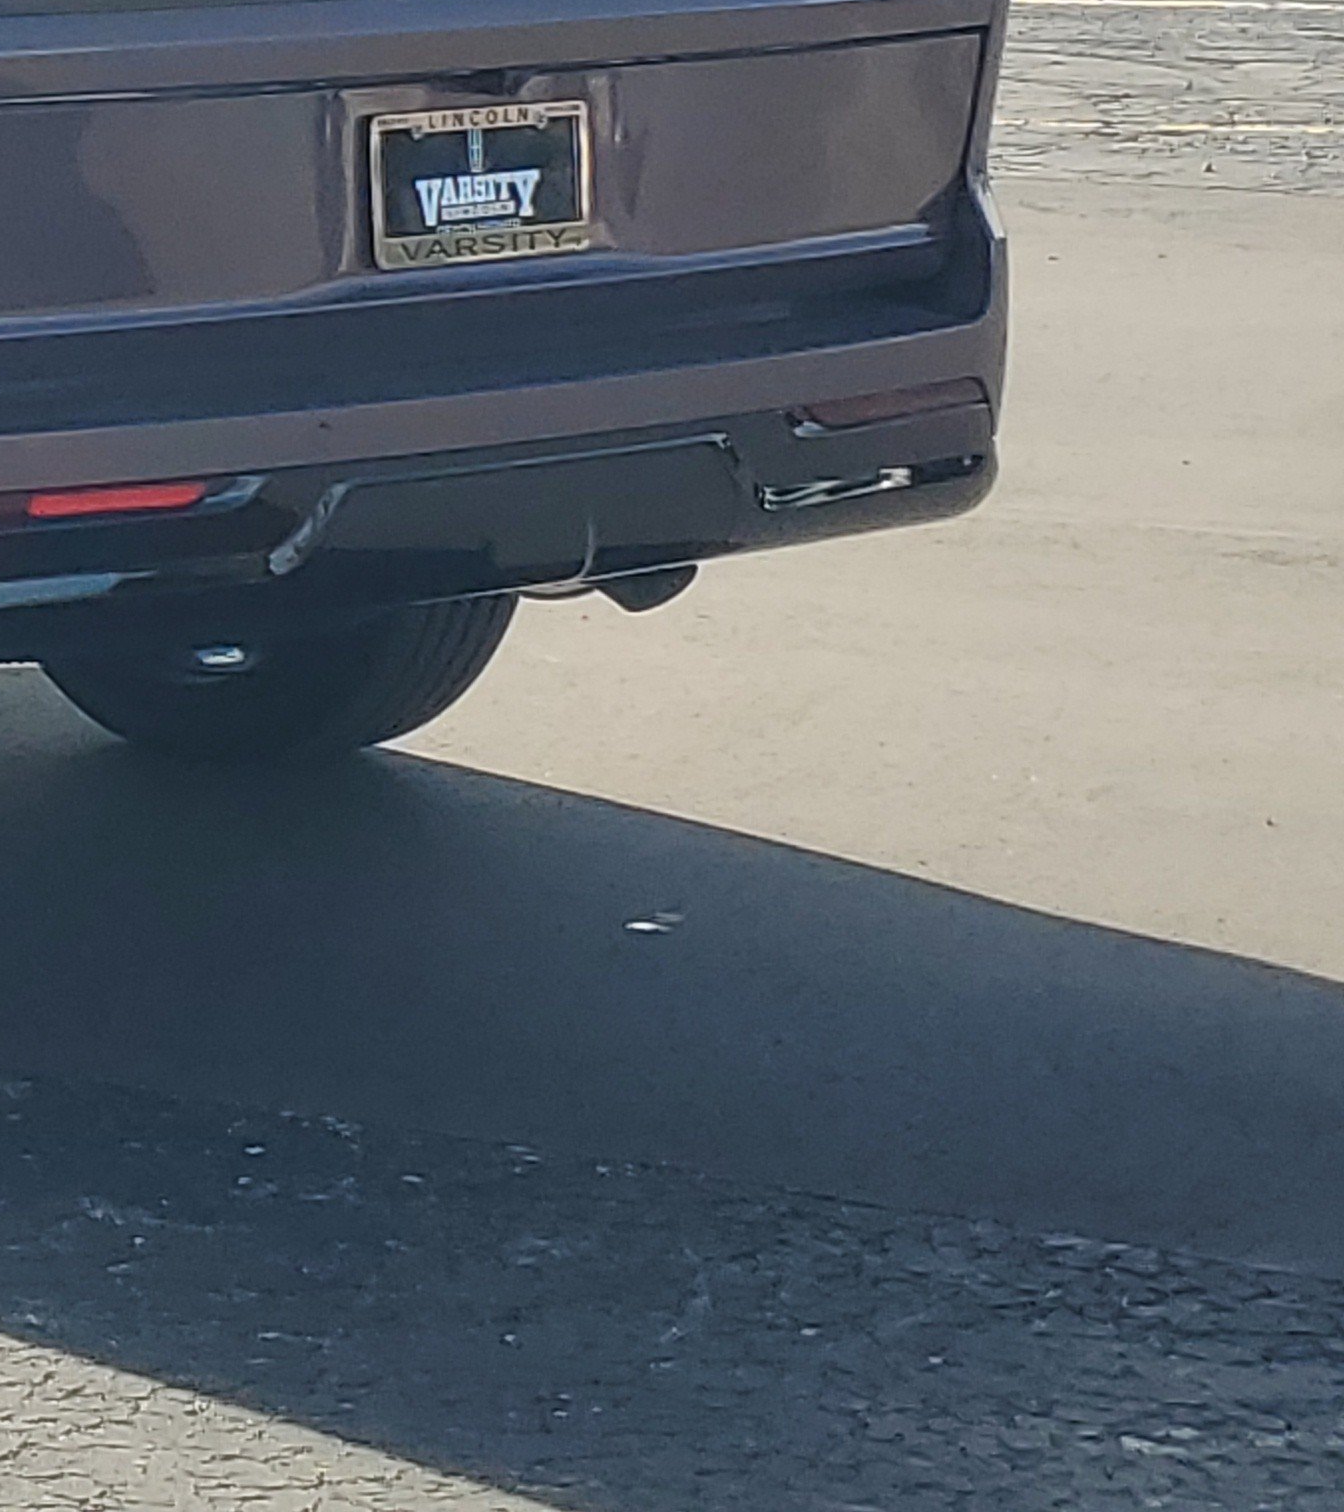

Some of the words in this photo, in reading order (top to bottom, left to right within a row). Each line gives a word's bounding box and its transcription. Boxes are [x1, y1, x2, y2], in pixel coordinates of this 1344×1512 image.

[428, 107, 530, 130] LINCOLN
[415, 168, 541, 227] VARSITY
[399, 228, 568, 262] VARSITY
